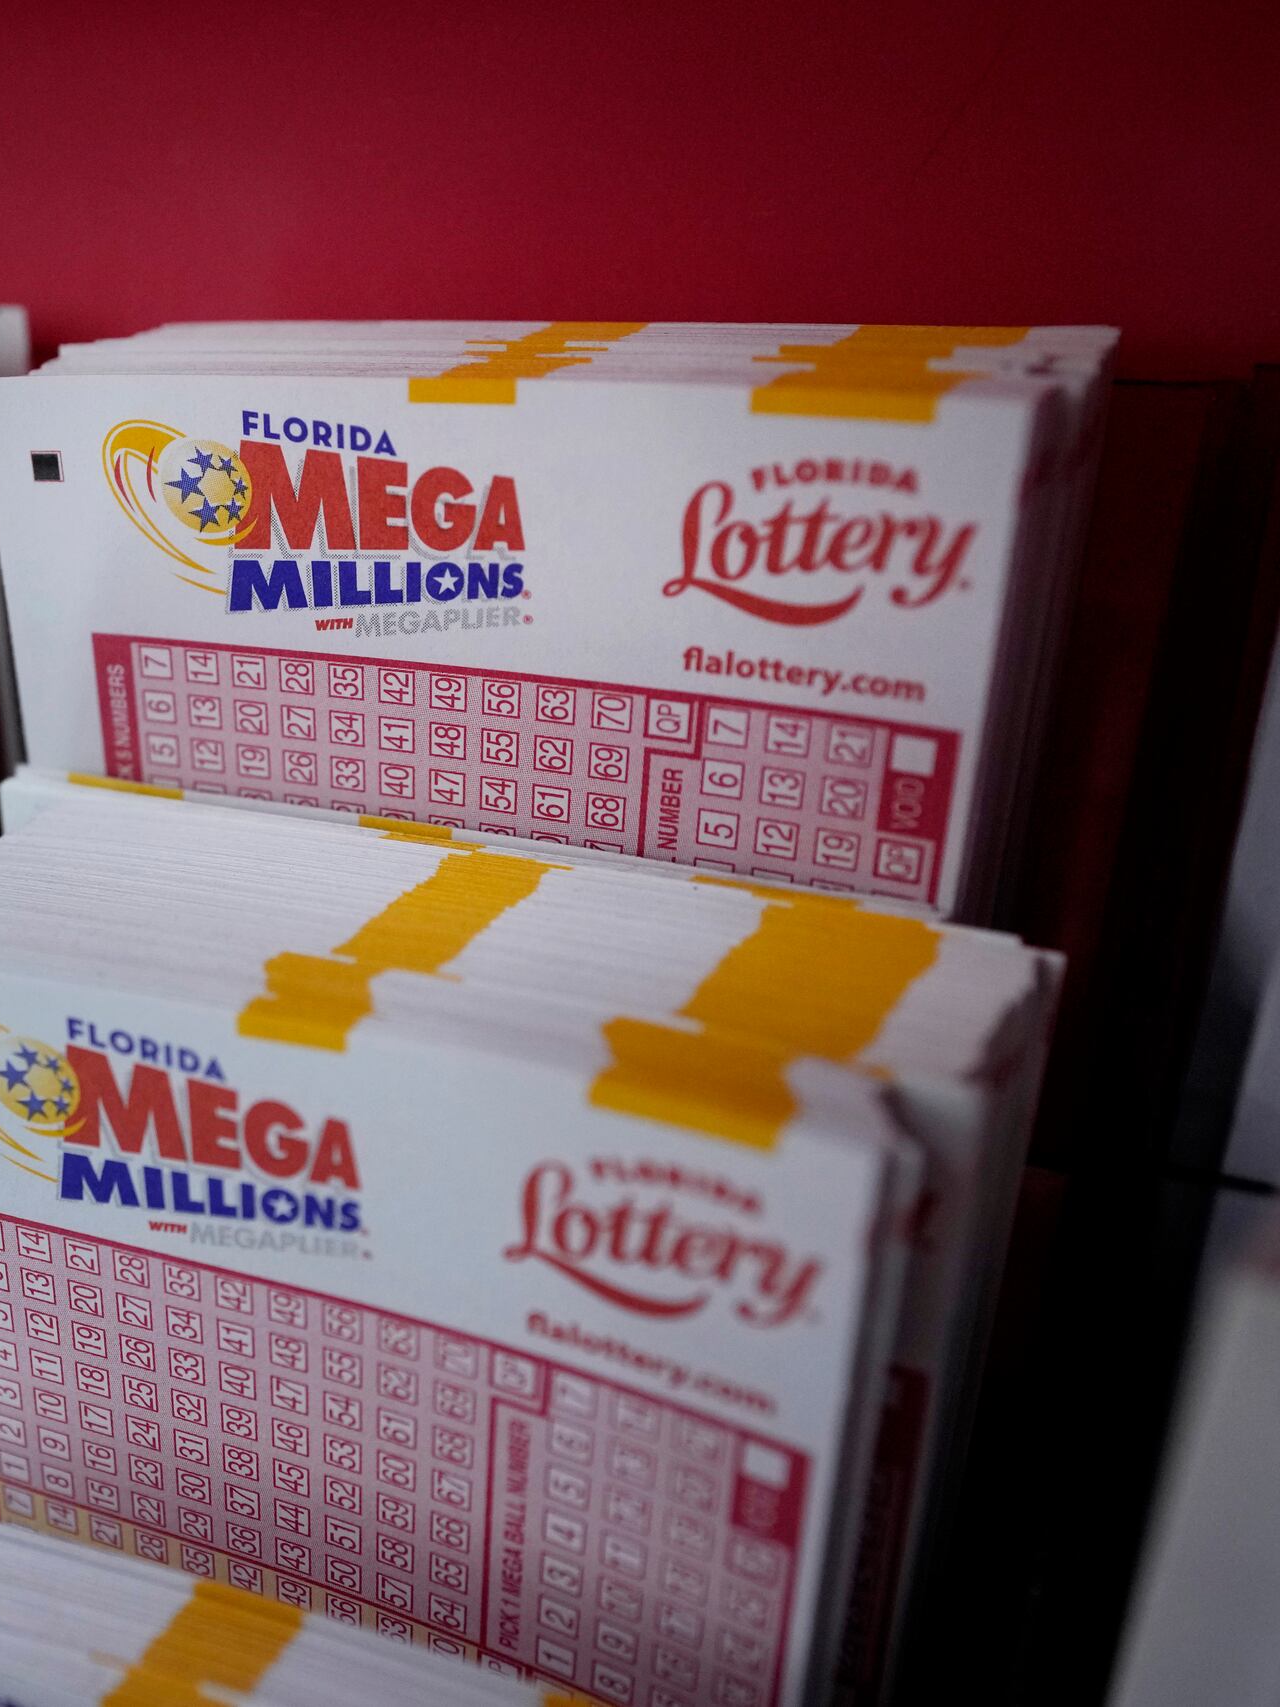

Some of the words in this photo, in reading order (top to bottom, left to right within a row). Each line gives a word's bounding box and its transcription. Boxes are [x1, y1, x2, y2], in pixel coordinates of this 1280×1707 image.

[242, 410, 397, 456] FLORIDA
[752, 457, 917, 494] FLORIDA
[234, 439, 526, 552] MEGA
[662, 481, 979, 627] Lottery
[229, 560, 524, 612] MILLIONS
[316, 617, 353, 632] WITH
[355, 607, 521, 638] MEGAPLIER
[144, 655, 168, 668] 7
[192, 653, 211, 680] 14
[236, 659, 261, 686] 21
[682, 646, 925, 701] flalottery.com
[285, 663, 310, 692] 28
[333, 668, 359, 696] 35
[383, 672, 409, 702] 42
[107, 663, 131, 748] NUMBERS
[149, 700, 171, 714] 6
[435, 677, 461, 708] 49
[488, 683, 515, 715] 56
[541, 688, 569, 720] 63
[196, 697, 217, 724] 13
[239, 704, 262, 735] 20
[287, 707, 311, 738] 27
[597, 696, 626, 727] 70
[657, 703, 681, 733] QP
[334, 714, 359, 743] 34
[384, 722, 409, 748] 41
[434, 726, 461, 755] 48
[713, 719, 743, 736] 7
[776, 719, 800, 752] 14
[151, 743, 175, 758] 5
[198, 742, 218, 767] 12
[242, 748, 265, 772] 19
[486, 732, 513, 763] 55
[539, 740, 567, 770] 62
[289, 752, 313, 782] 26
[335, 759, 361, 789] 33
[594, 747, 623, 778] 69
[383, 766, 409, 794] 40
[434, 773, 460, 802] 47
[708, 772, 738, 788] 6
[770, 778, 800, 805] 13
[485, 781, 512, 810] 54
[536, 790, 565, 818] 61
[657, 768, 683, 850] NUMBER
[891, 778, 925, 828] VOID
[592, 796, 620, 827] 68
[704, 821, 734, 839] 5
[763, 824, 794, 852] 12
[823, 841, 855, 866] 19
[66, 1017, 226, 1082] FLORIDA
[62, 1045, 360, 1191] MEGA
[61, 1152, 361, 1232] MILLIONS
[20, 1230, 47, 1255] 14
[149, 1220, 187, 1235] WITH
[190, 1221, 359, 1258] MEGAPLIER
[503, 1159, 822, 1328] Lottery
[70, 1242, 95, 1269] 21
[23, 1272, 50, 1296] 13
[120, 1257, 145, 1286] 28
[170, 1267, 194, 1297] 35
[71, 1285, 98, 1314] 20
[220, 1279, 247, 1308] 42
[123, 1296, 148, 1326] 27
[172, 1310, 198, 1340] 34
[29, 1316, 55, 1338] 12
[75, 1327, 101, 1352] 19
[222, 1328, 248, 1353] 41
[126, 1339, 151, 1368] 26
[174, 1352, 199, 1381] 33
[274, 1336, 301, 1368] 48
[33, 1357, 58, 1378] 11
[79, 1367, 105, 1391] 18
[224, 1367, 249, 1395] 40
[38, 1394, 62, 1418] 10
[126, 1380, 153, 1408] 25
[177, 1393, 202, 1422] 32
[276, 1380, 302, 1410] 47
[83, 1406, 108, 1429] 17
[226, 1409, 251, 1437] 39
[329, 1397, 354, 1427] 54
[0, 1424, 20, 1438] 2
[131, 1418, 156, 1447] 24
[277, 1422, 303, 1451] 46
[382, 1413, 409, 1442] 61
[43, 1438, 66, 1451] 9
[87, 1446, 111, 1471] 16
[178, 1436, 204, 1462] 31
[328, 1440, 354, 1469] 53
[135, 1461, 158, 1486] 23
[228, 1450, 253, 1479] 38
[278, 1464, 304, 1494] 45
[382, 1456, 409, 1485] 60
[47, 1476, 69, 1489] 8
[91, 1483, 115, 1508] 15
[181, 1479, 206, 1503] 30
[329, 1481, 355, 1510] 52
[137, 1499, 162, 1525] 22
[230, 1489, 254, 1517] 37
[382, 1501, 408, 1531] 59
[181, 1512, 207, 1536] 29
[279, 1504, 304, 1532] 44
[436, 1516, 464, 1548] 66
[95, 1521, 117, 1545] 21
[231, 1526, 255, 1554] 36
[329, 1527, 356, 1552] 51
[141, 1535, 163, 1561] 28
[280, 1543, 305, 1570] 43
[382, 1542, 408, 1570] 58
[186, 1549, 209, 1577] 35
[234, 1564, 257, 1590] 42
[330, 1563, 357, 1588] 50
[436, 1562, 462, 1591] 65
[382, 1582, 407, 1611] 57
[434, 1601, 461, 1629] 64
[546, 1606, 573, 1623] 2
[499, 1612, 519, 1650] PICK
